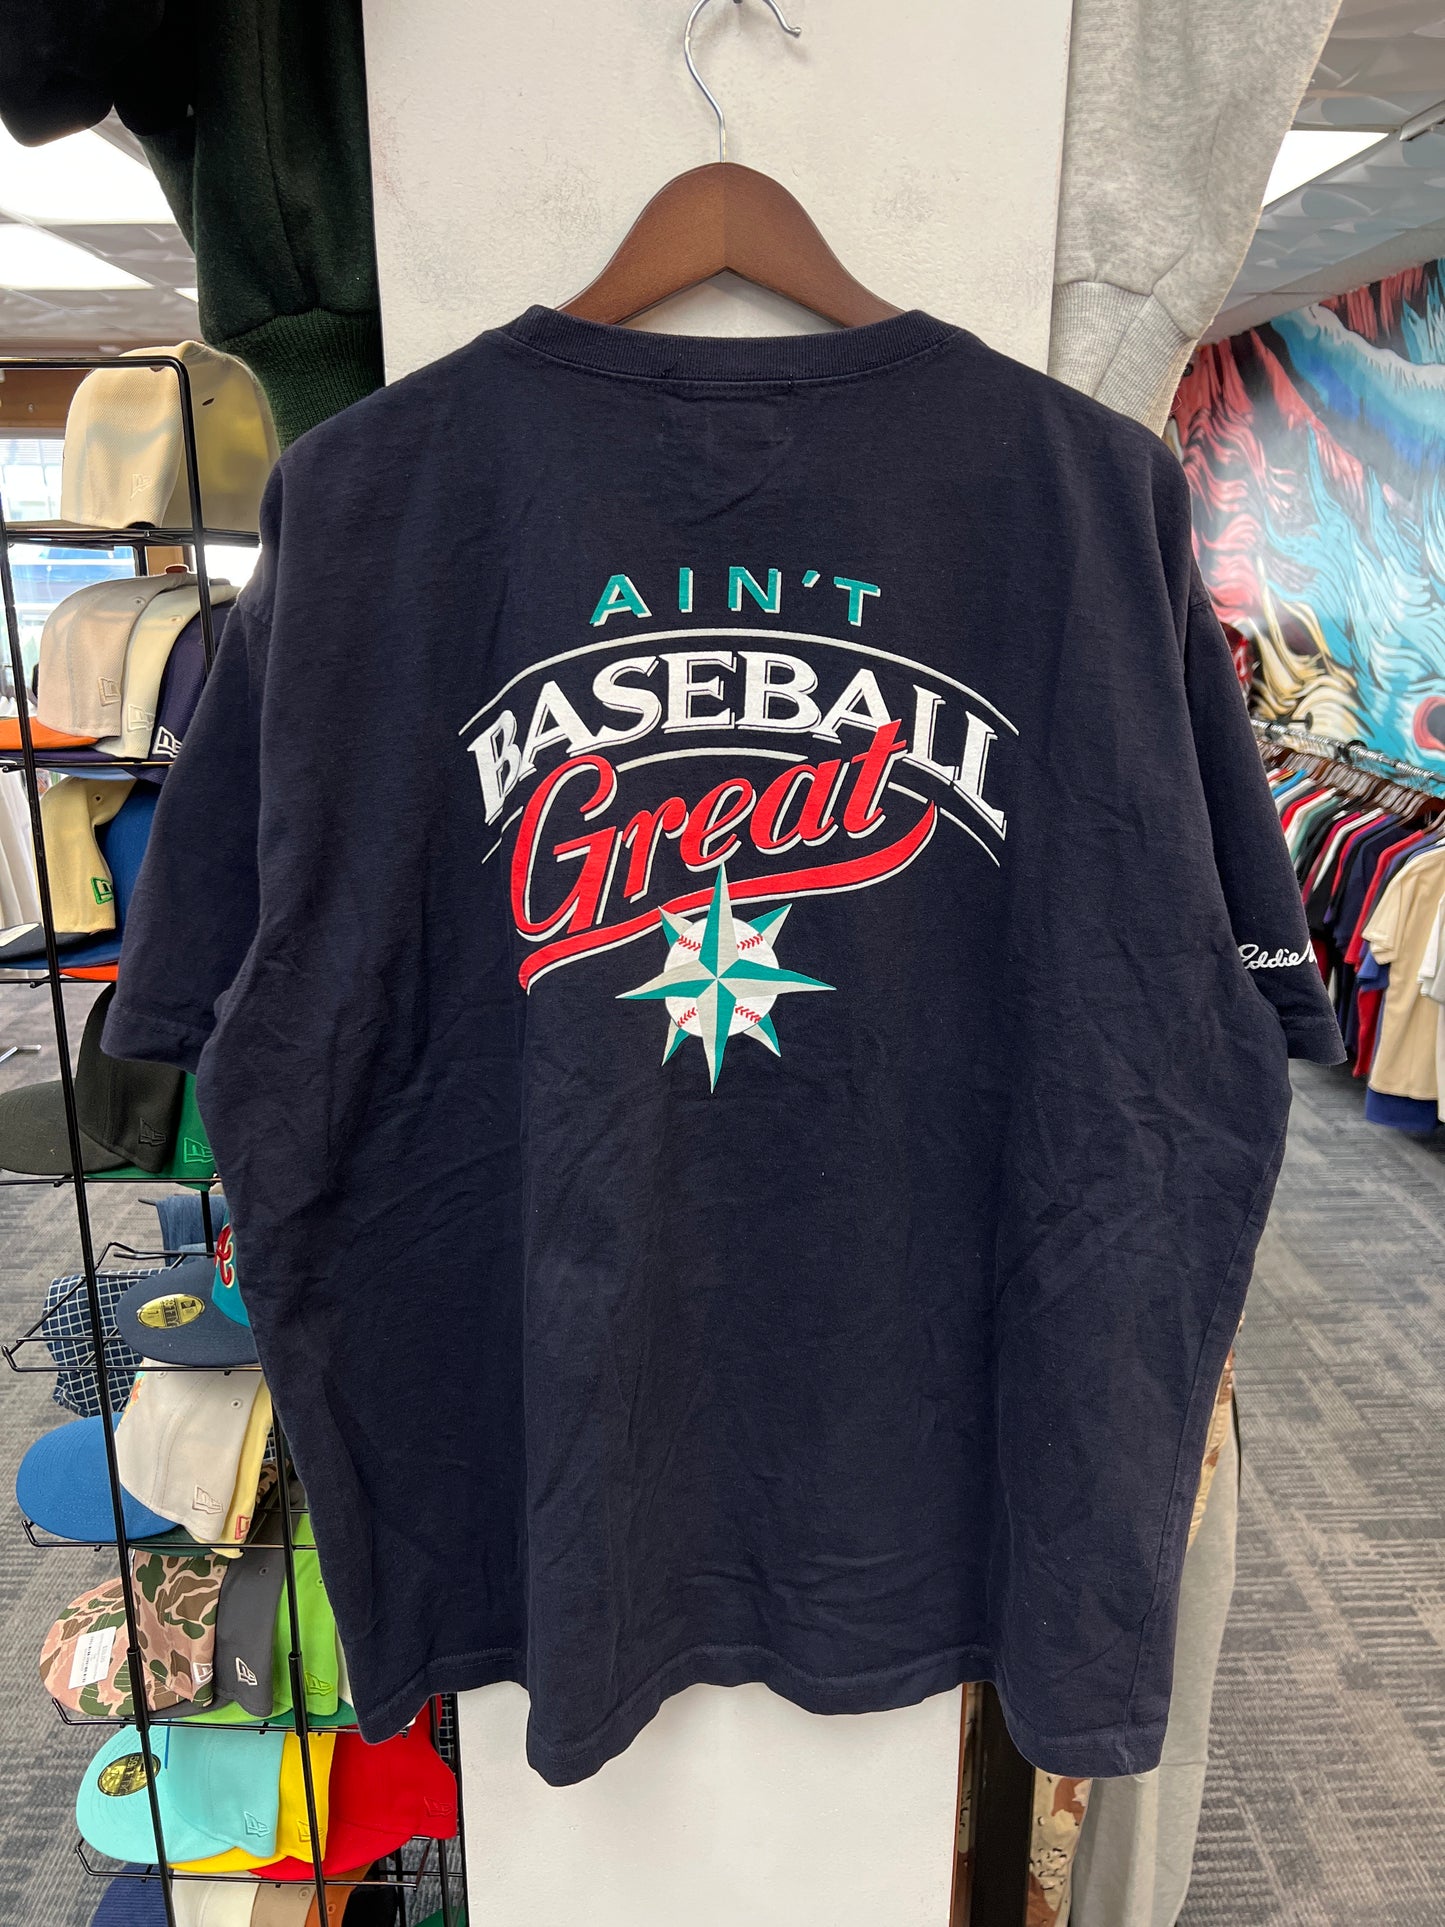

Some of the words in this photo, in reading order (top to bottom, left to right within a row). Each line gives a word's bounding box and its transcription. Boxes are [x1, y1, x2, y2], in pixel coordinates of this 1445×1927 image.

[588, 566, 881, 627] AIN'T
[467, 650, 1006, 841] BASEBALL
[510, 719, 907, 942] Great
[1237, 943, 1302, 970] Eddie
